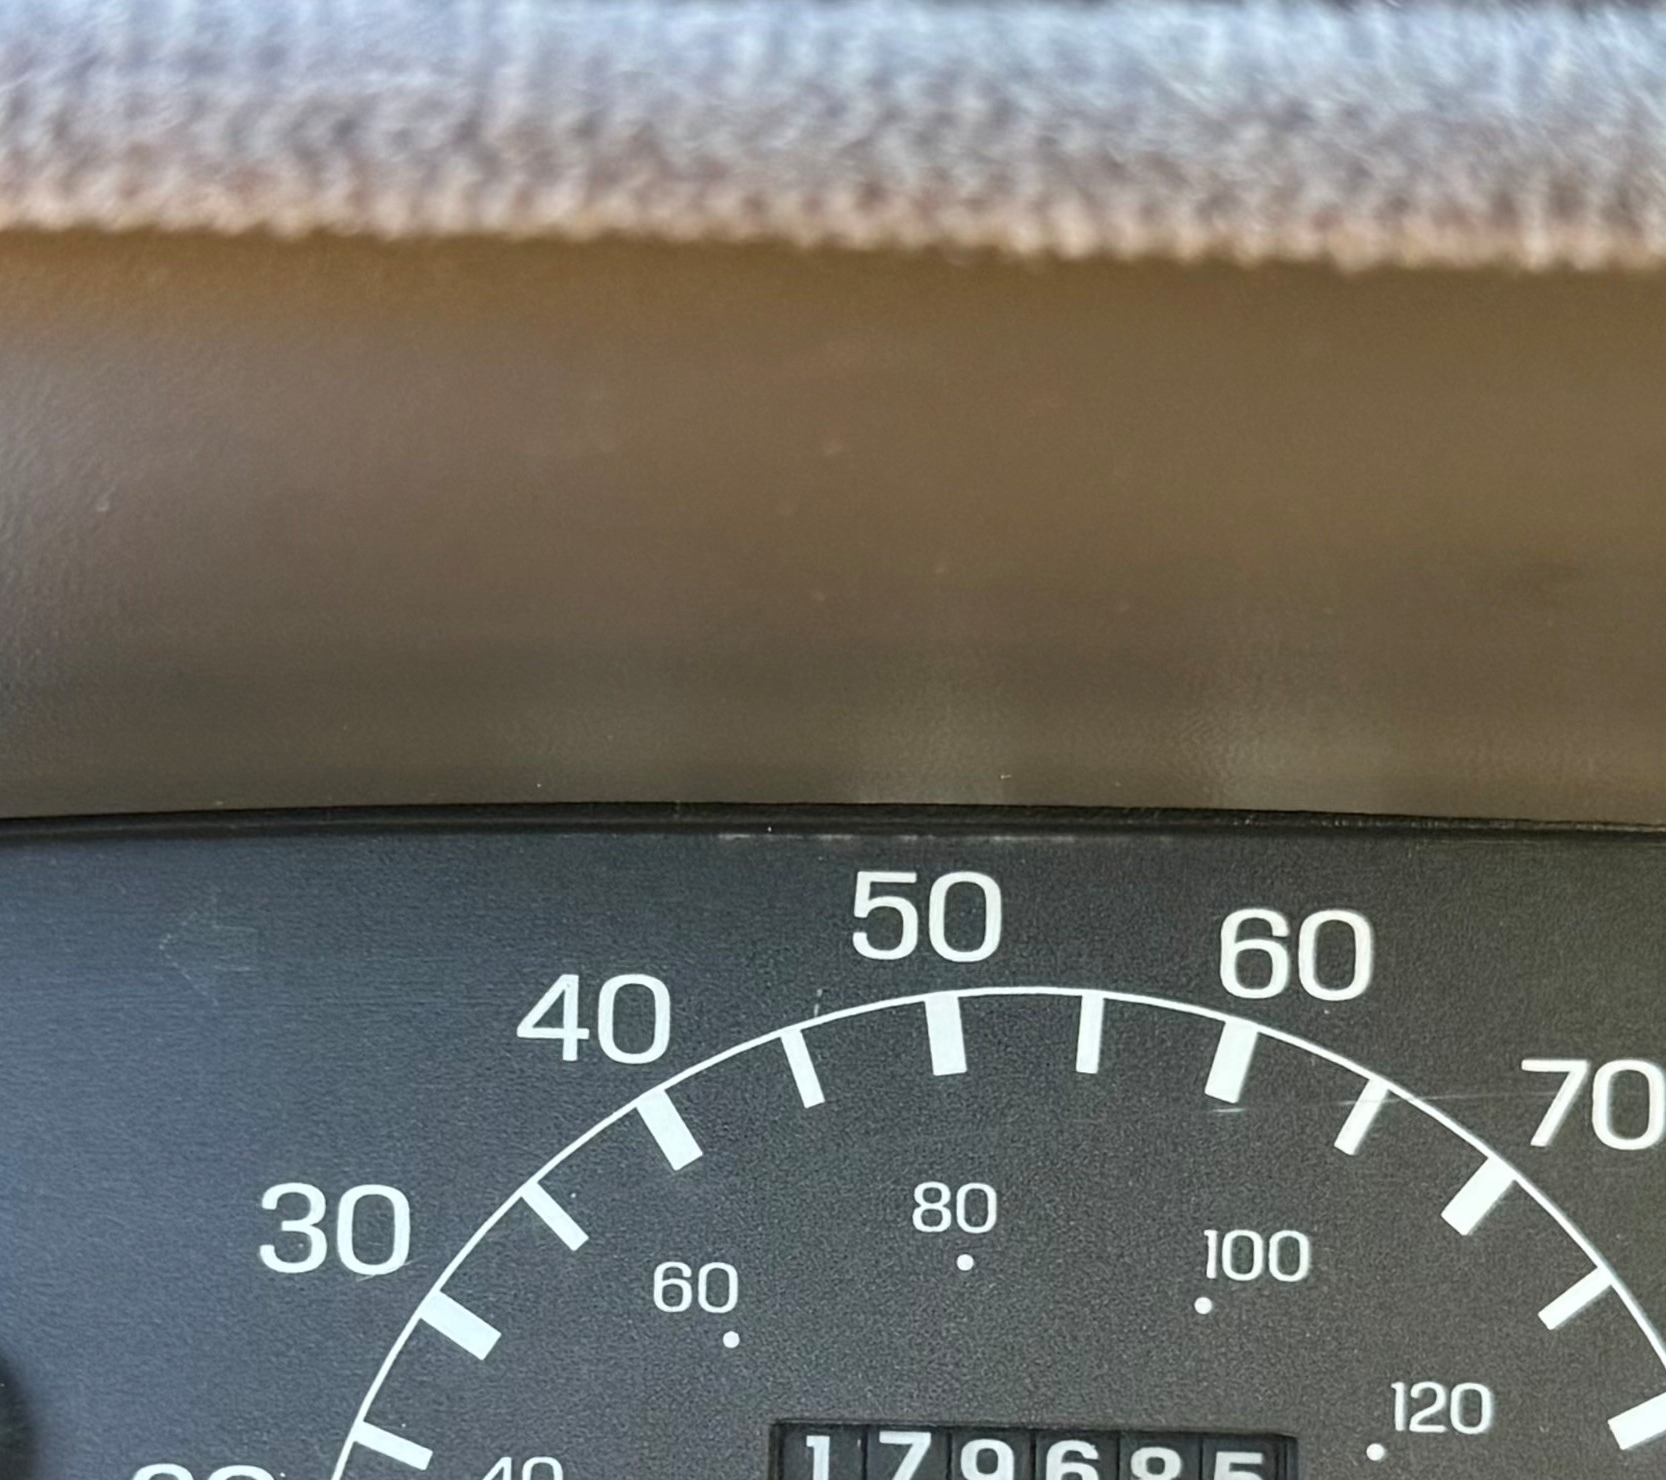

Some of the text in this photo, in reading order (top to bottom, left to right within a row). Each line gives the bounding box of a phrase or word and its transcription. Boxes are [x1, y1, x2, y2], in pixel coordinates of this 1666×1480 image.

[851, 869, 1003, 964] 50
[1218, 906, 1374, 1003] 60
[515, 972, 672, 1066] 40
[258, 1181, 412, 1275] 30
[911, 1180, 998, 1235] 80
[652, 1260, 740, 1315] 60
[1203, 1228, 1312, 1283] 100
[1390, 1380, 1495, 1436] 120
